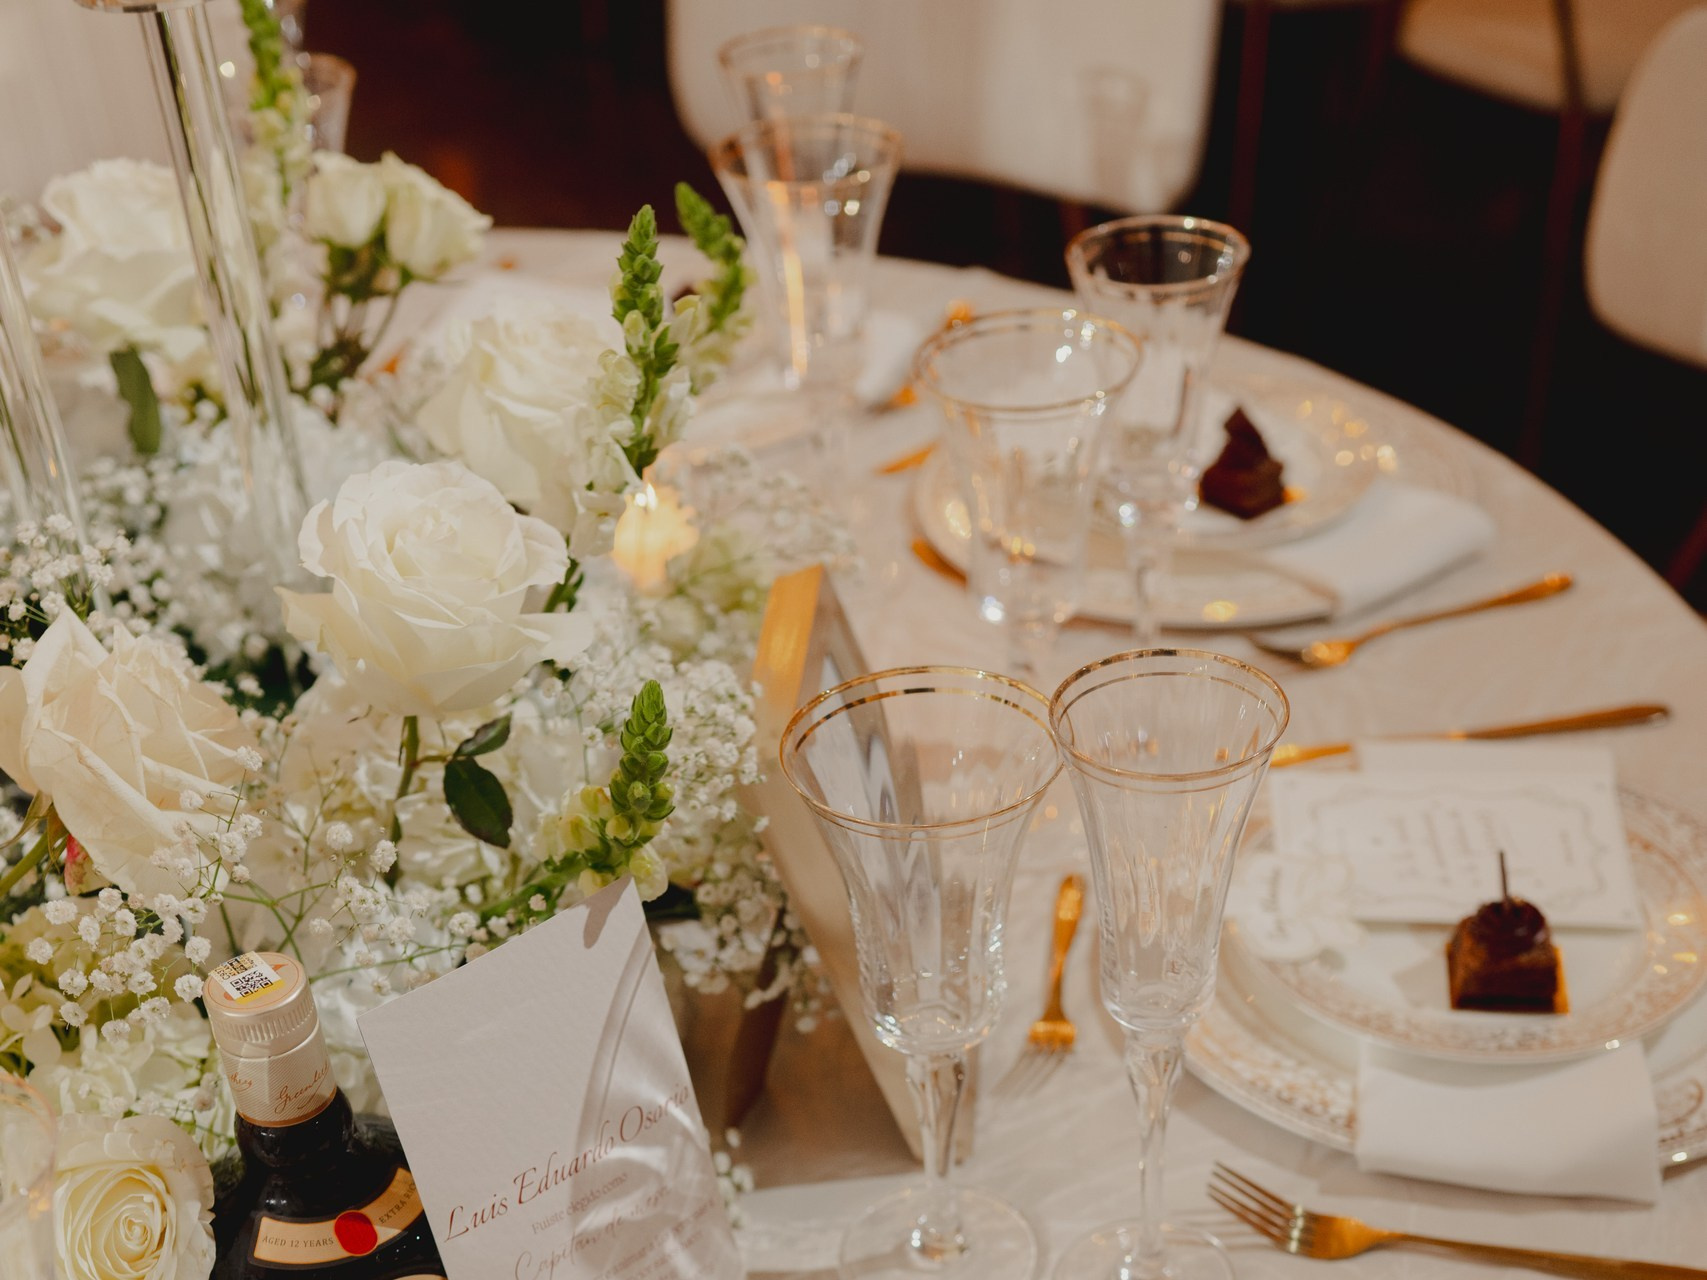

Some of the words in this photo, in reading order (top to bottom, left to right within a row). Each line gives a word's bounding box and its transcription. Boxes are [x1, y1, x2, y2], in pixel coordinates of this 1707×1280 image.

[443, 1194, 508, 1244] Luis
[513, 1120, 615, 1204] Eduardo
[379, 1200, 407, 1224] EXTRA
[262, 1235, 286, 1247] AGED
[290, 1238, 301, 1248] 12
[303, 1237, 334, 1248] YEARS
